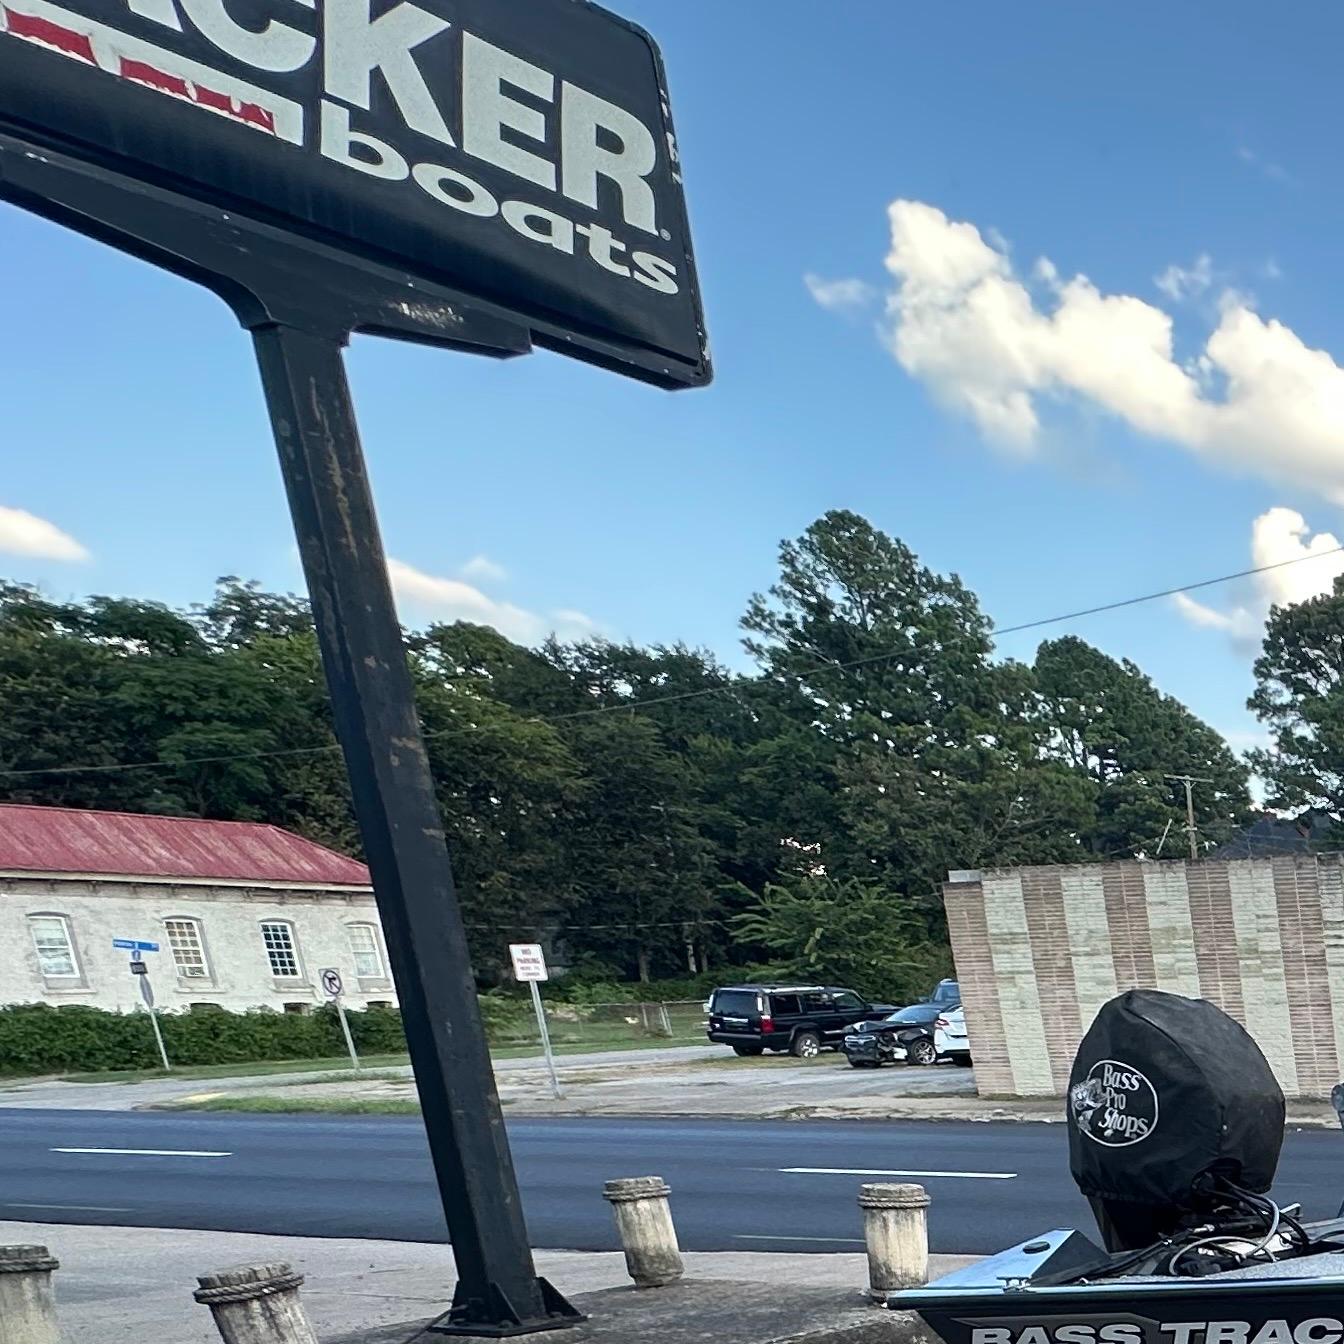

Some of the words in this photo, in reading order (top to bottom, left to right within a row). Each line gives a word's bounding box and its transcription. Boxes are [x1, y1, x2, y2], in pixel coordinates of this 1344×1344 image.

[128, 0, 661, 239] CKER
[320, 99, 679, 295] boats
[1103, 1064, 1141, 1090] Bass
[1105, 1087, 1126, 1110] Pro
[1098, 1107, 1149, 1137] Shops
